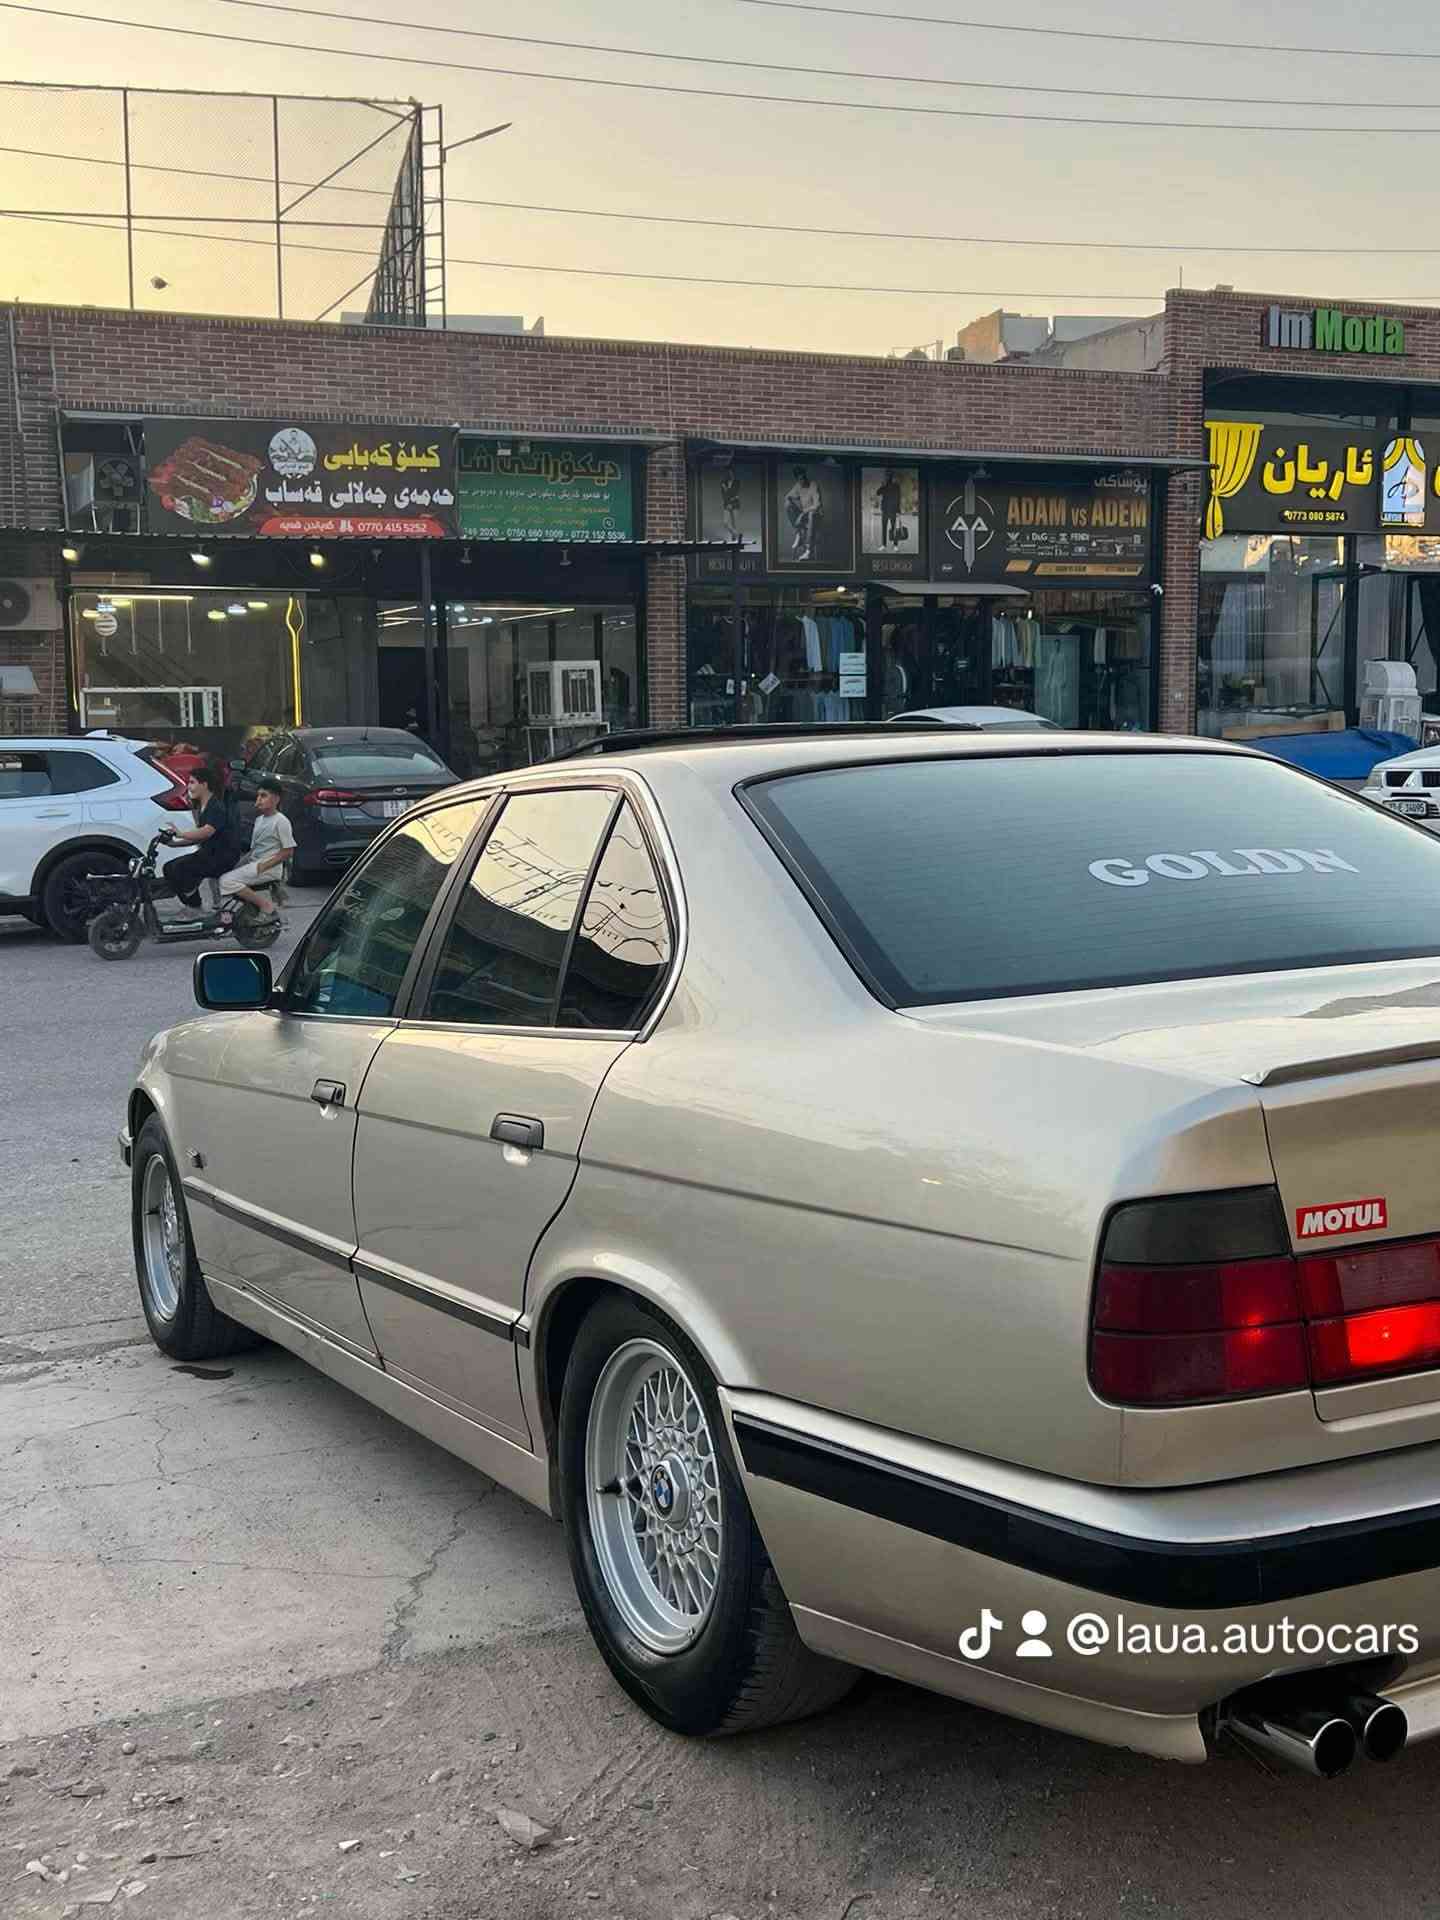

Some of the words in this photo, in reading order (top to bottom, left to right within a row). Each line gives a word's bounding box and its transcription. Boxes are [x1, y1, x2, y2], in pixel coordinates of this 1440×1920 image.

[1263, 444, 1374, 501] ئاریان
[358, 521, 384, 532] 0770
[384, 521, 401, 532] 415
[1007, 497, 1066, 526] ADAM
[1091, 501, 1147, 528] ADEM
[1287, 511, 1307, 520] 0773
[1301, 1202, 1385, 1236] MOTUL
